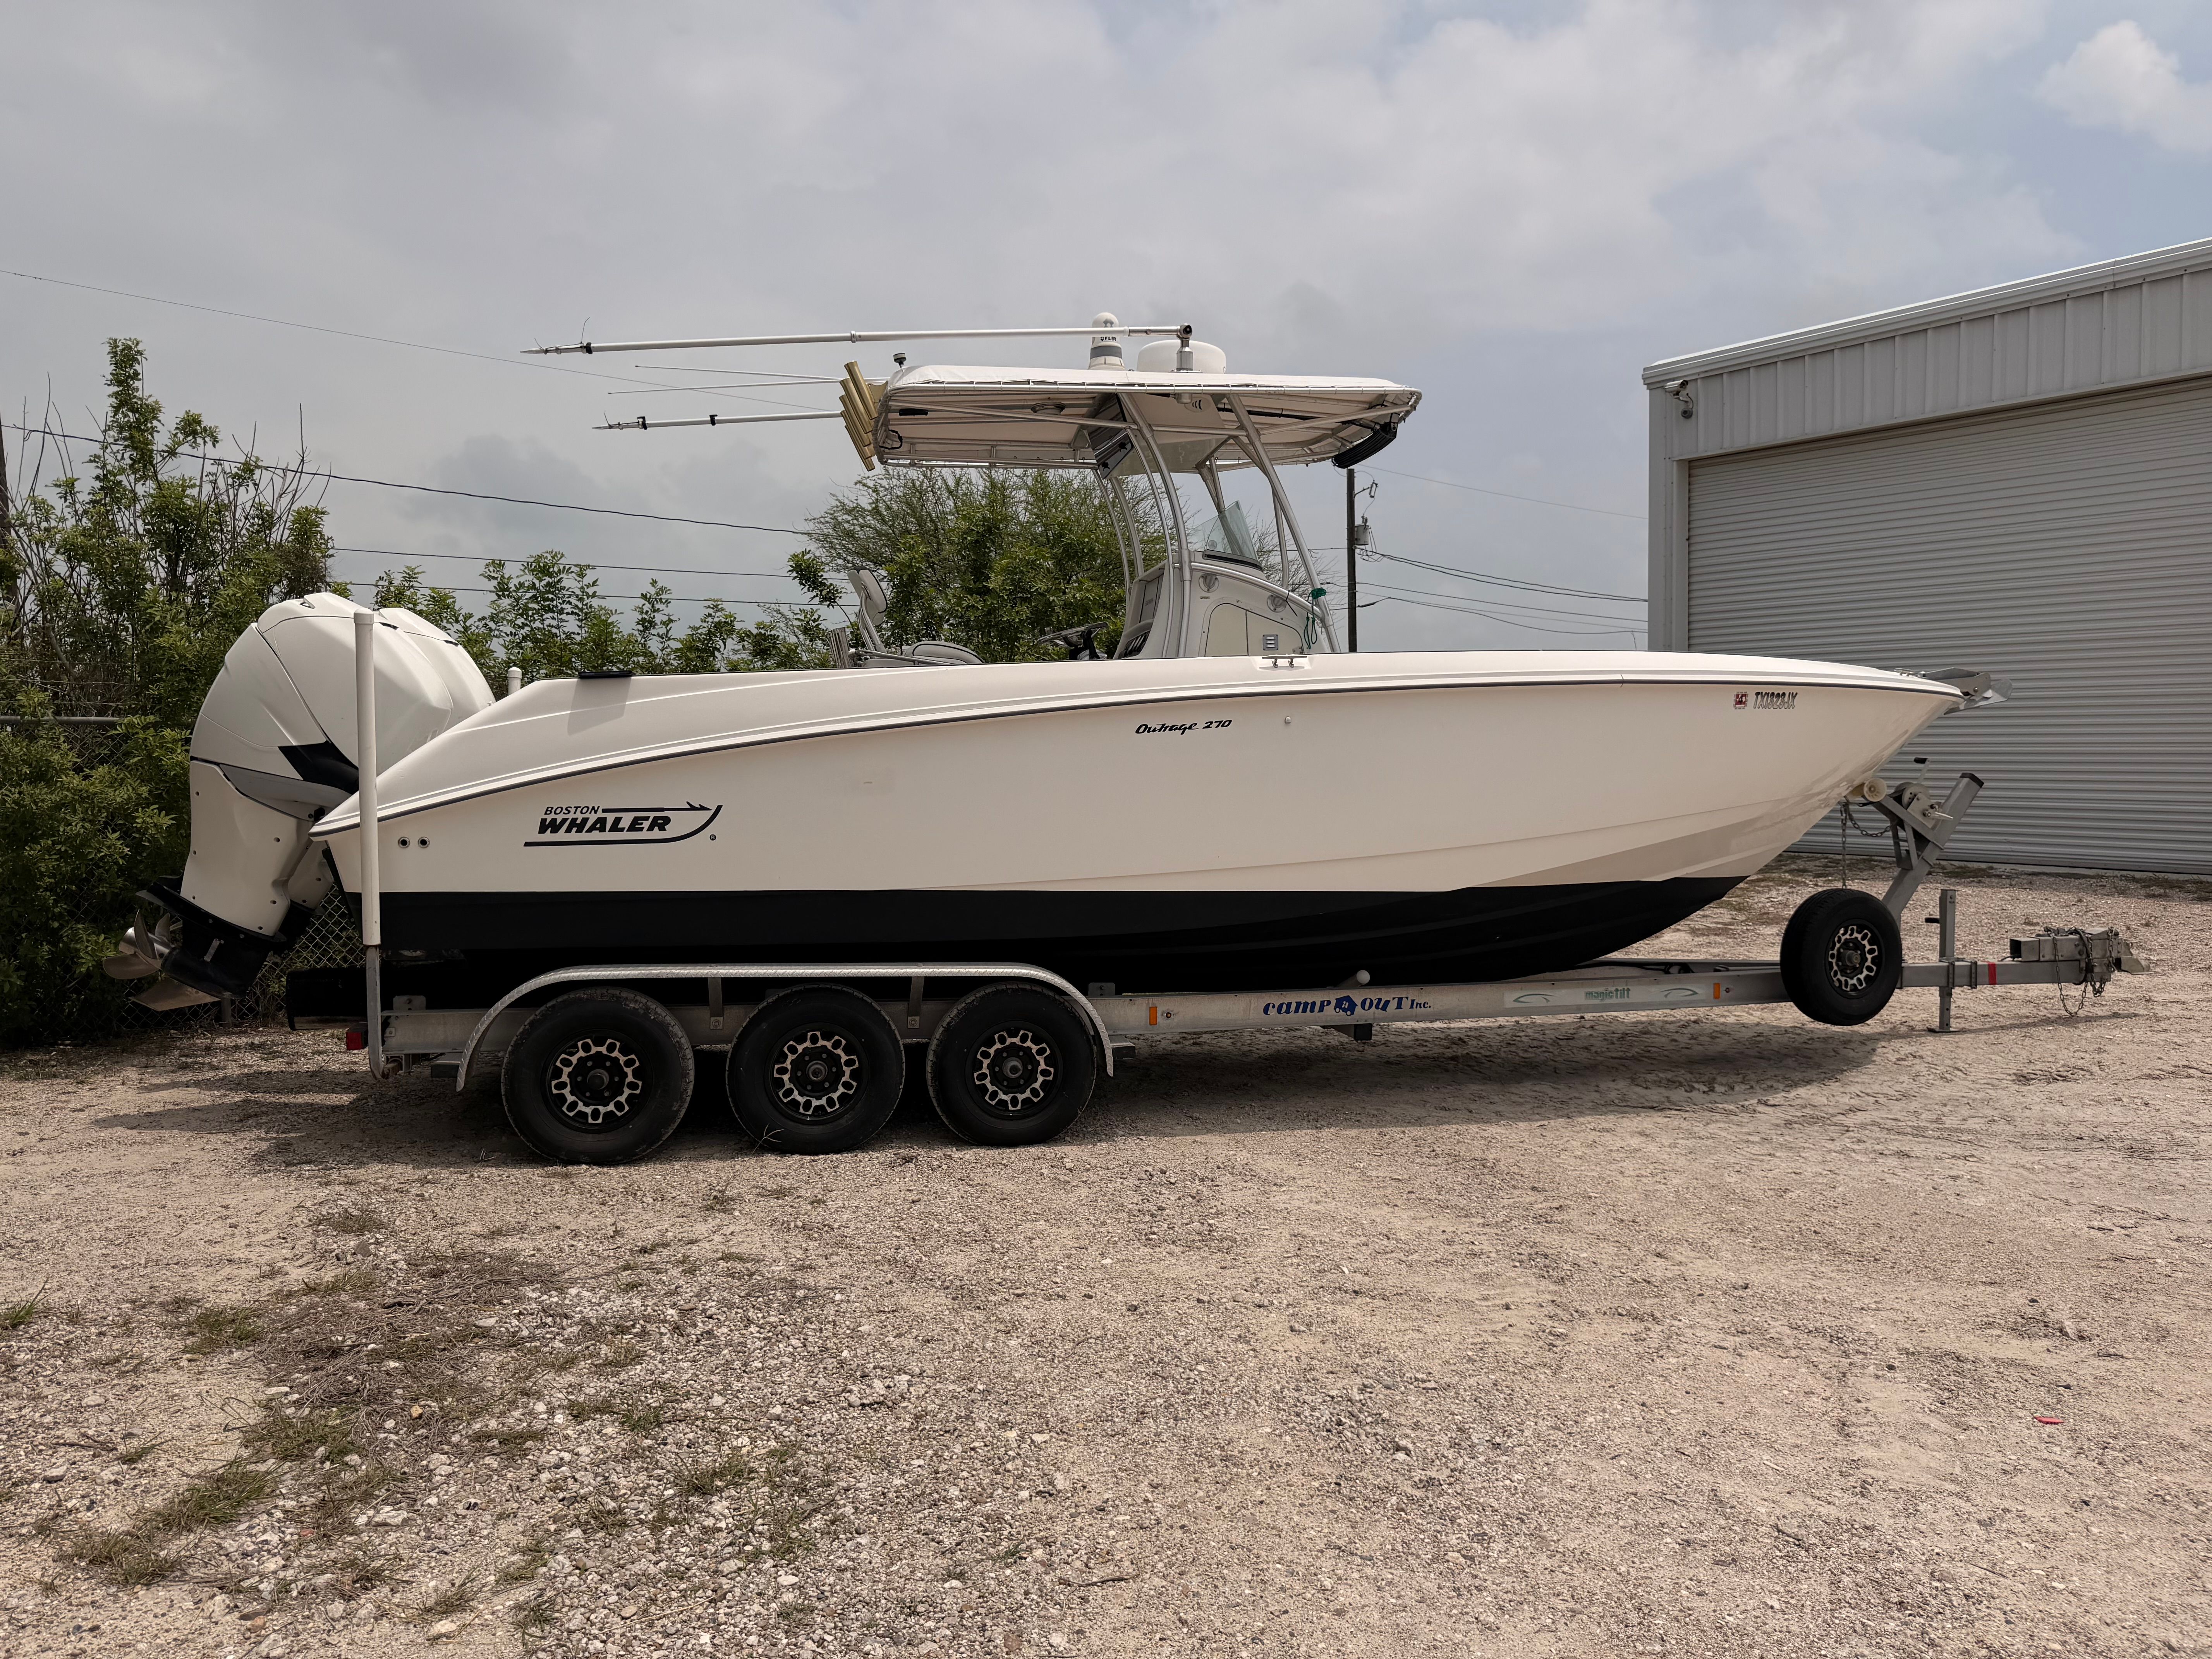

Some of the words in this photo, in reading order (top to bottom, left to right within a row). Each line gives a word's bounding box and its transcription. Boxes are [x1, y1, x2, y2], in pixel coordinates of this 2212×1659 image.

[1753, 692, 1798, 709] TX1323JX
[1135, 722, 1199, 735] Outrage
[1202, 720, 1232, 729] 270
[544, 806, 600, 815] BOSTON
[538, 816, 671, 834] WHALER
[1409, 999, 1431, 1009] Inc.
